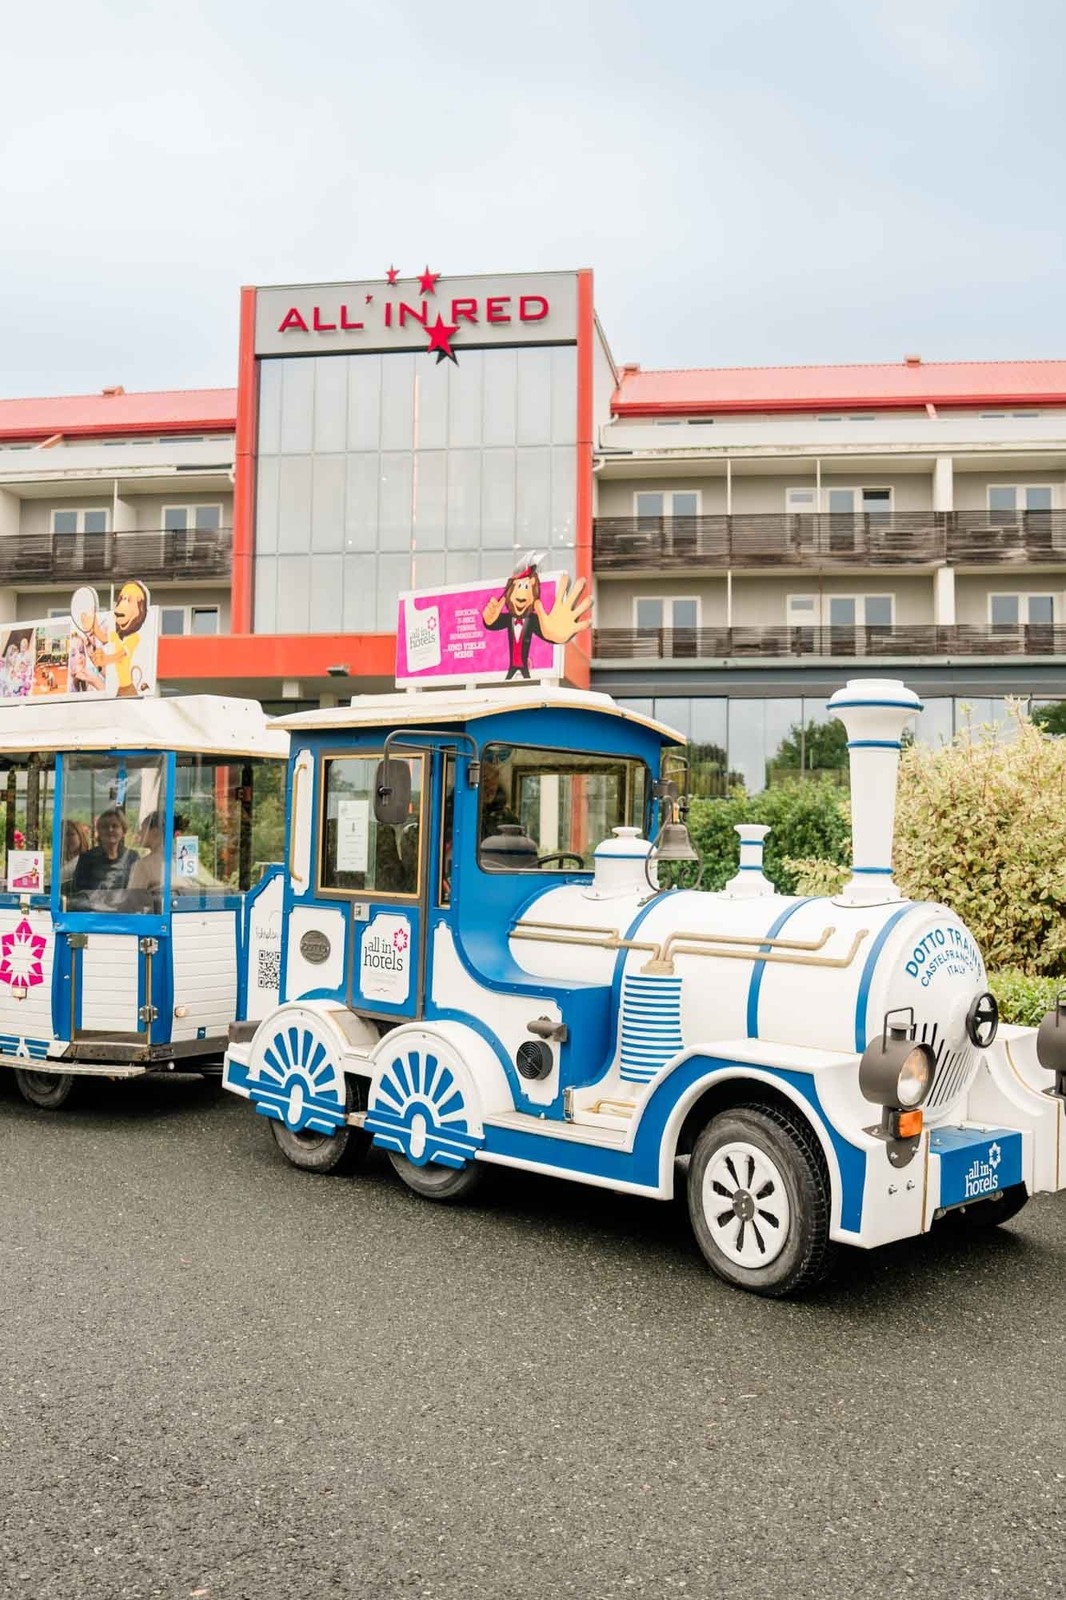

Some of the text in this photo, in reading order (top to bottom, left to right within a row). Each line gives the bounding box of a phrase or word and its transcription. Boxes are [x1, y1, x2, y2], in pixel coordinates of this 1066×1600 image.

[278, 296, 549, 332] ALL IN RED
[410, 631, 436, 650] hotels
[368, 936, 392, 954] all in
[905, 928, 945, 978] DOTTO
[363, 947, 404, 972] hotels
[947, 964, 966, 976] ITALY
[968, 1160, 990, 1180] all in
[964, 1168, 999, 1198] hotels
